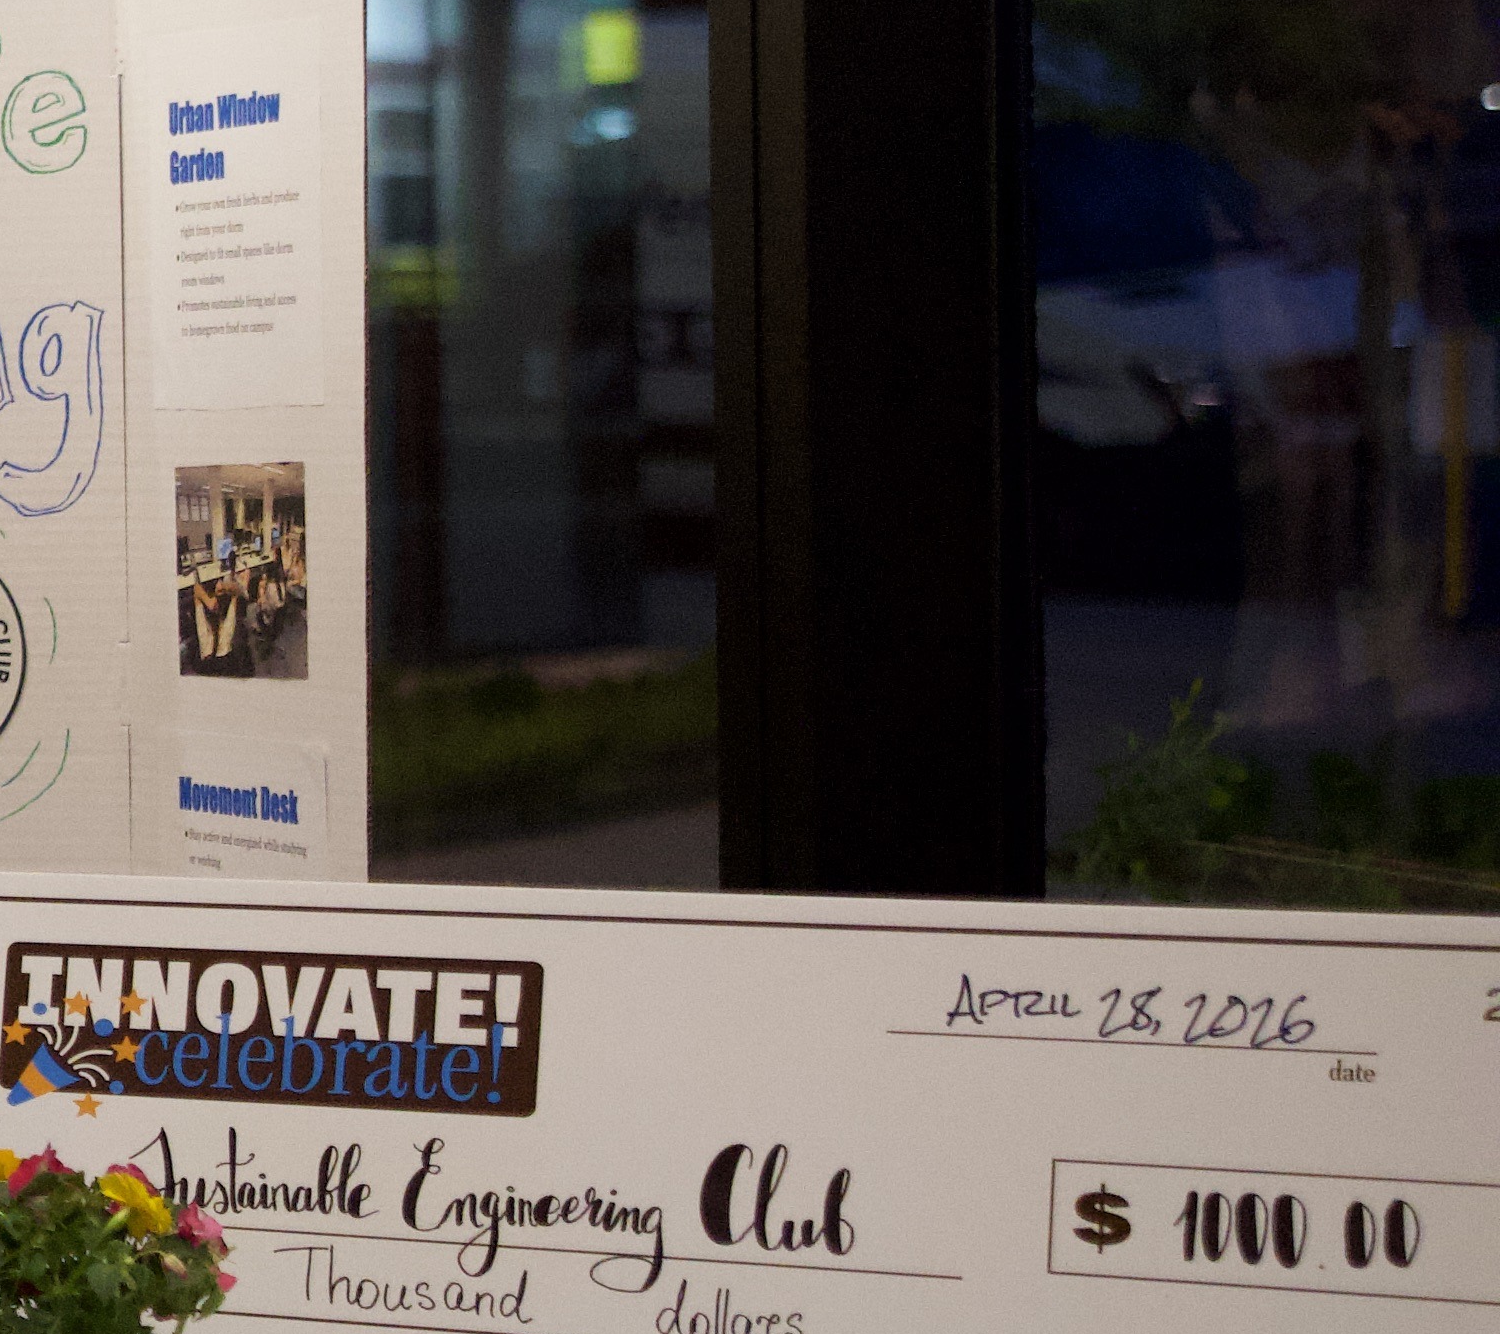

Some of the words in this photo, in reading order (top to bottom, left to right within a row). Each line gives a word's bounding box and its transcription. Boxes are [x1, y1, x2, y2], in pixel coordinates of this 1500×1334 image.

[169, 101, 214, 136] Urban
[217, 91, 279, 130] Window
[170, 148, 224, 185] Garden
[179, 776, 257, 819] Movement
[261, 786, 299, 824] Desk
[18, 955, 522, 1047] INNOVATE!
[1099, 986, 1162, 1038] 28,
[1184, 993, 1314, 1048] 2026
[134, 1012, 503, 1104] celebrate!
[1329, 1059, 1376, 1084] date
[402, 1137, 663, 1293] Engineering
[700, 1143, 855, 1256] Club
[1073, 1183, 1131, 1254] $
[273, 1244, 532, 1325] Thousand
